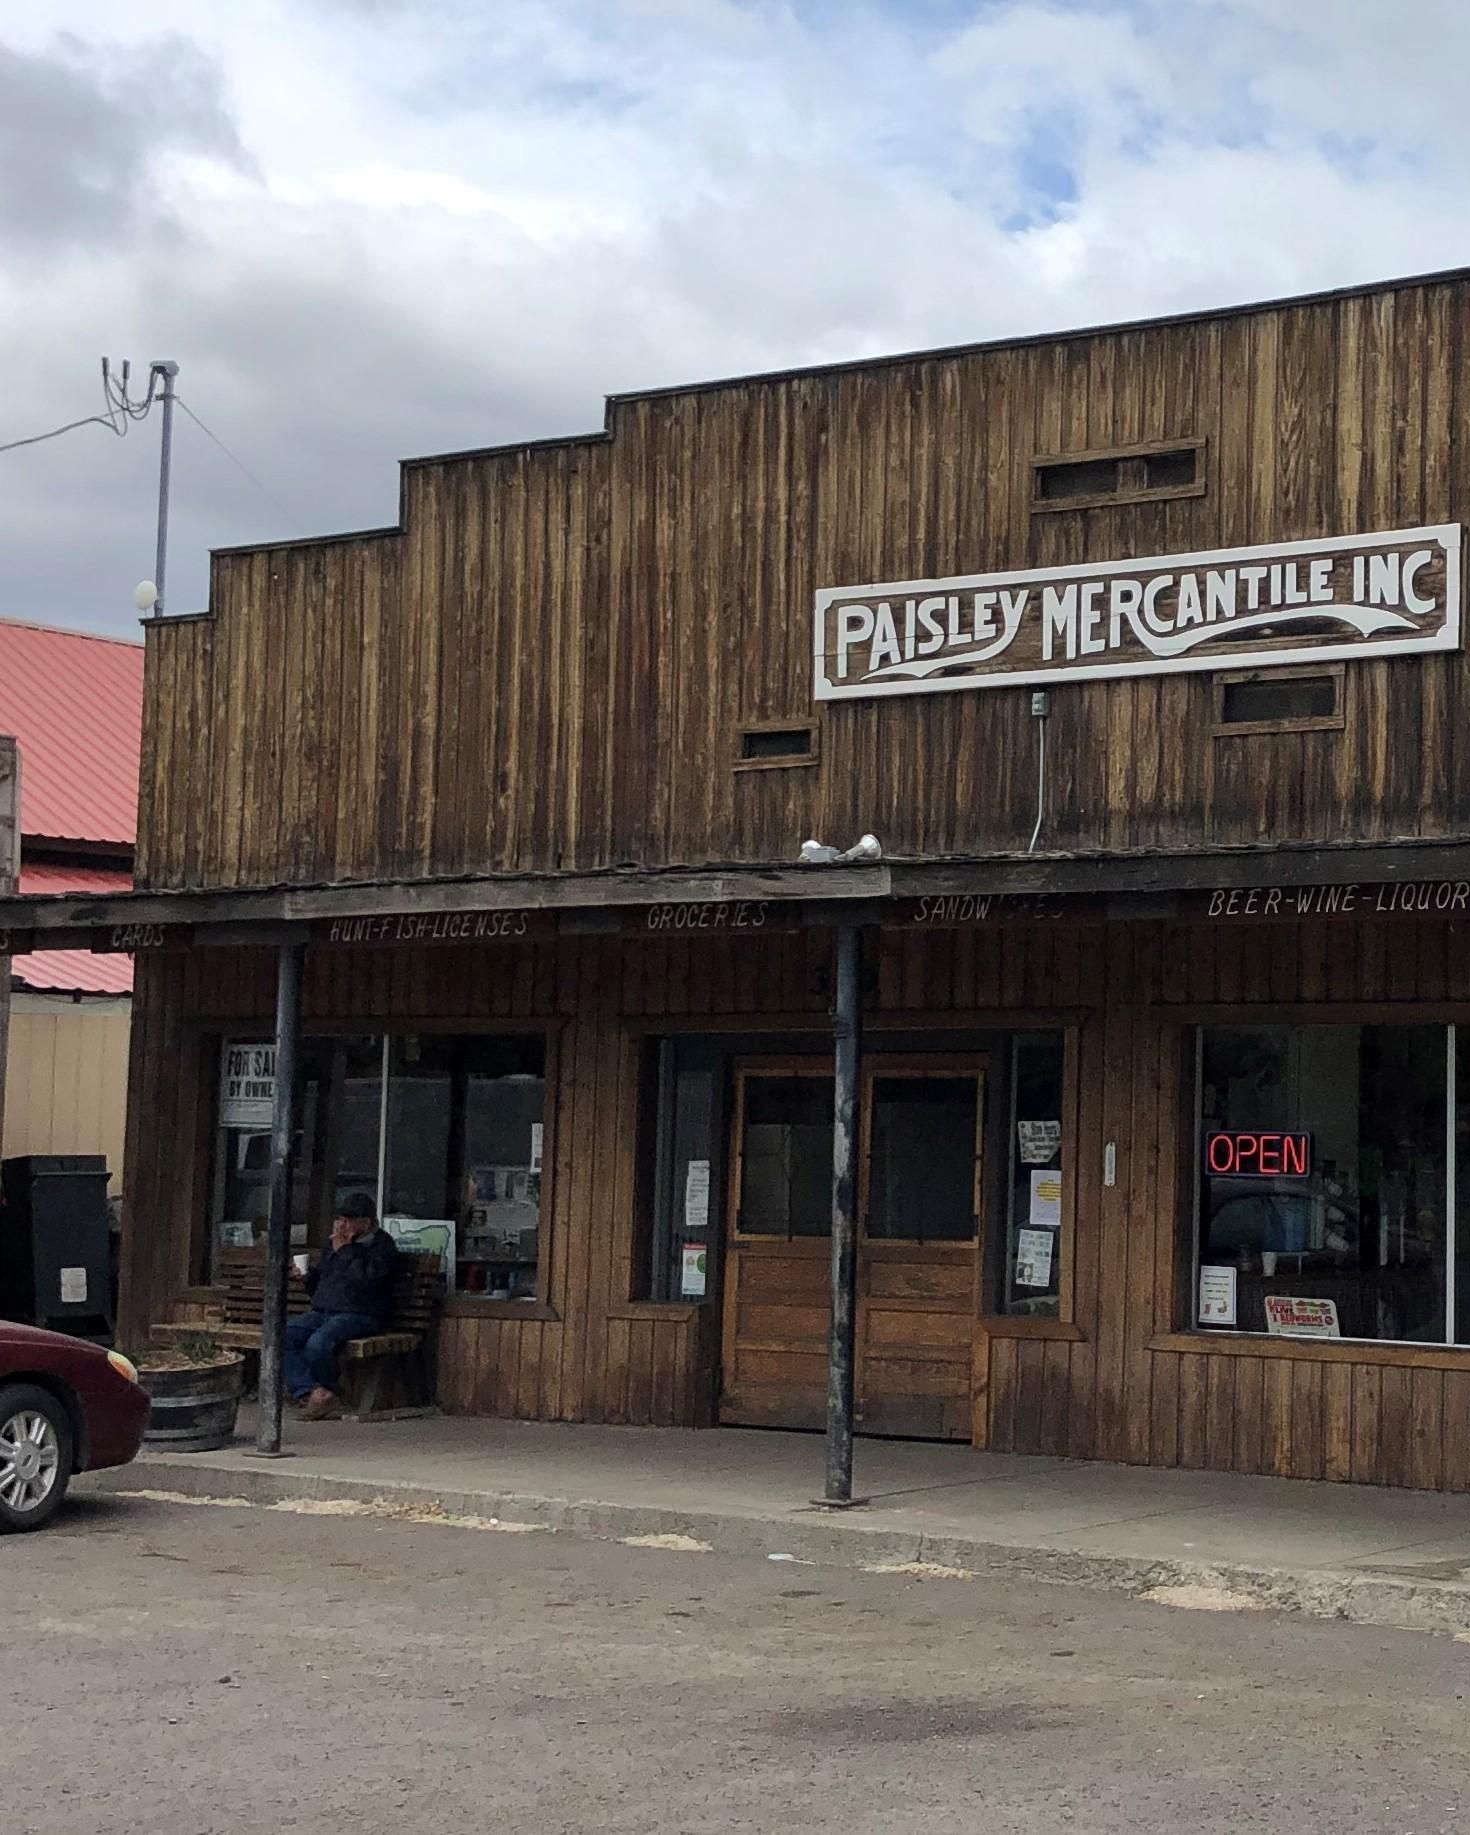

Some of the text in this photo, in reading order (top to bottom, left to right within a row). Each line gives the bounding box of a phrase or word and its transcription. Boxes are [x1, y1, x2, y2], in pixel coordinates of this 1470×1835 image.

[837, 549, 1437, 680] PAISLEY MERCANTILE INC
[330, 913, 529, 942] HUNT-FISH-LICENSES
[647, 901, 769, 930] GROCERIES
[112, 924, 166, 948] CARDS
[227, 1049, 250, 1077] FOR
[228, 1080, 274, 1098] BY OWNE
[1210, 1135, 1306, 1174] OPEN
